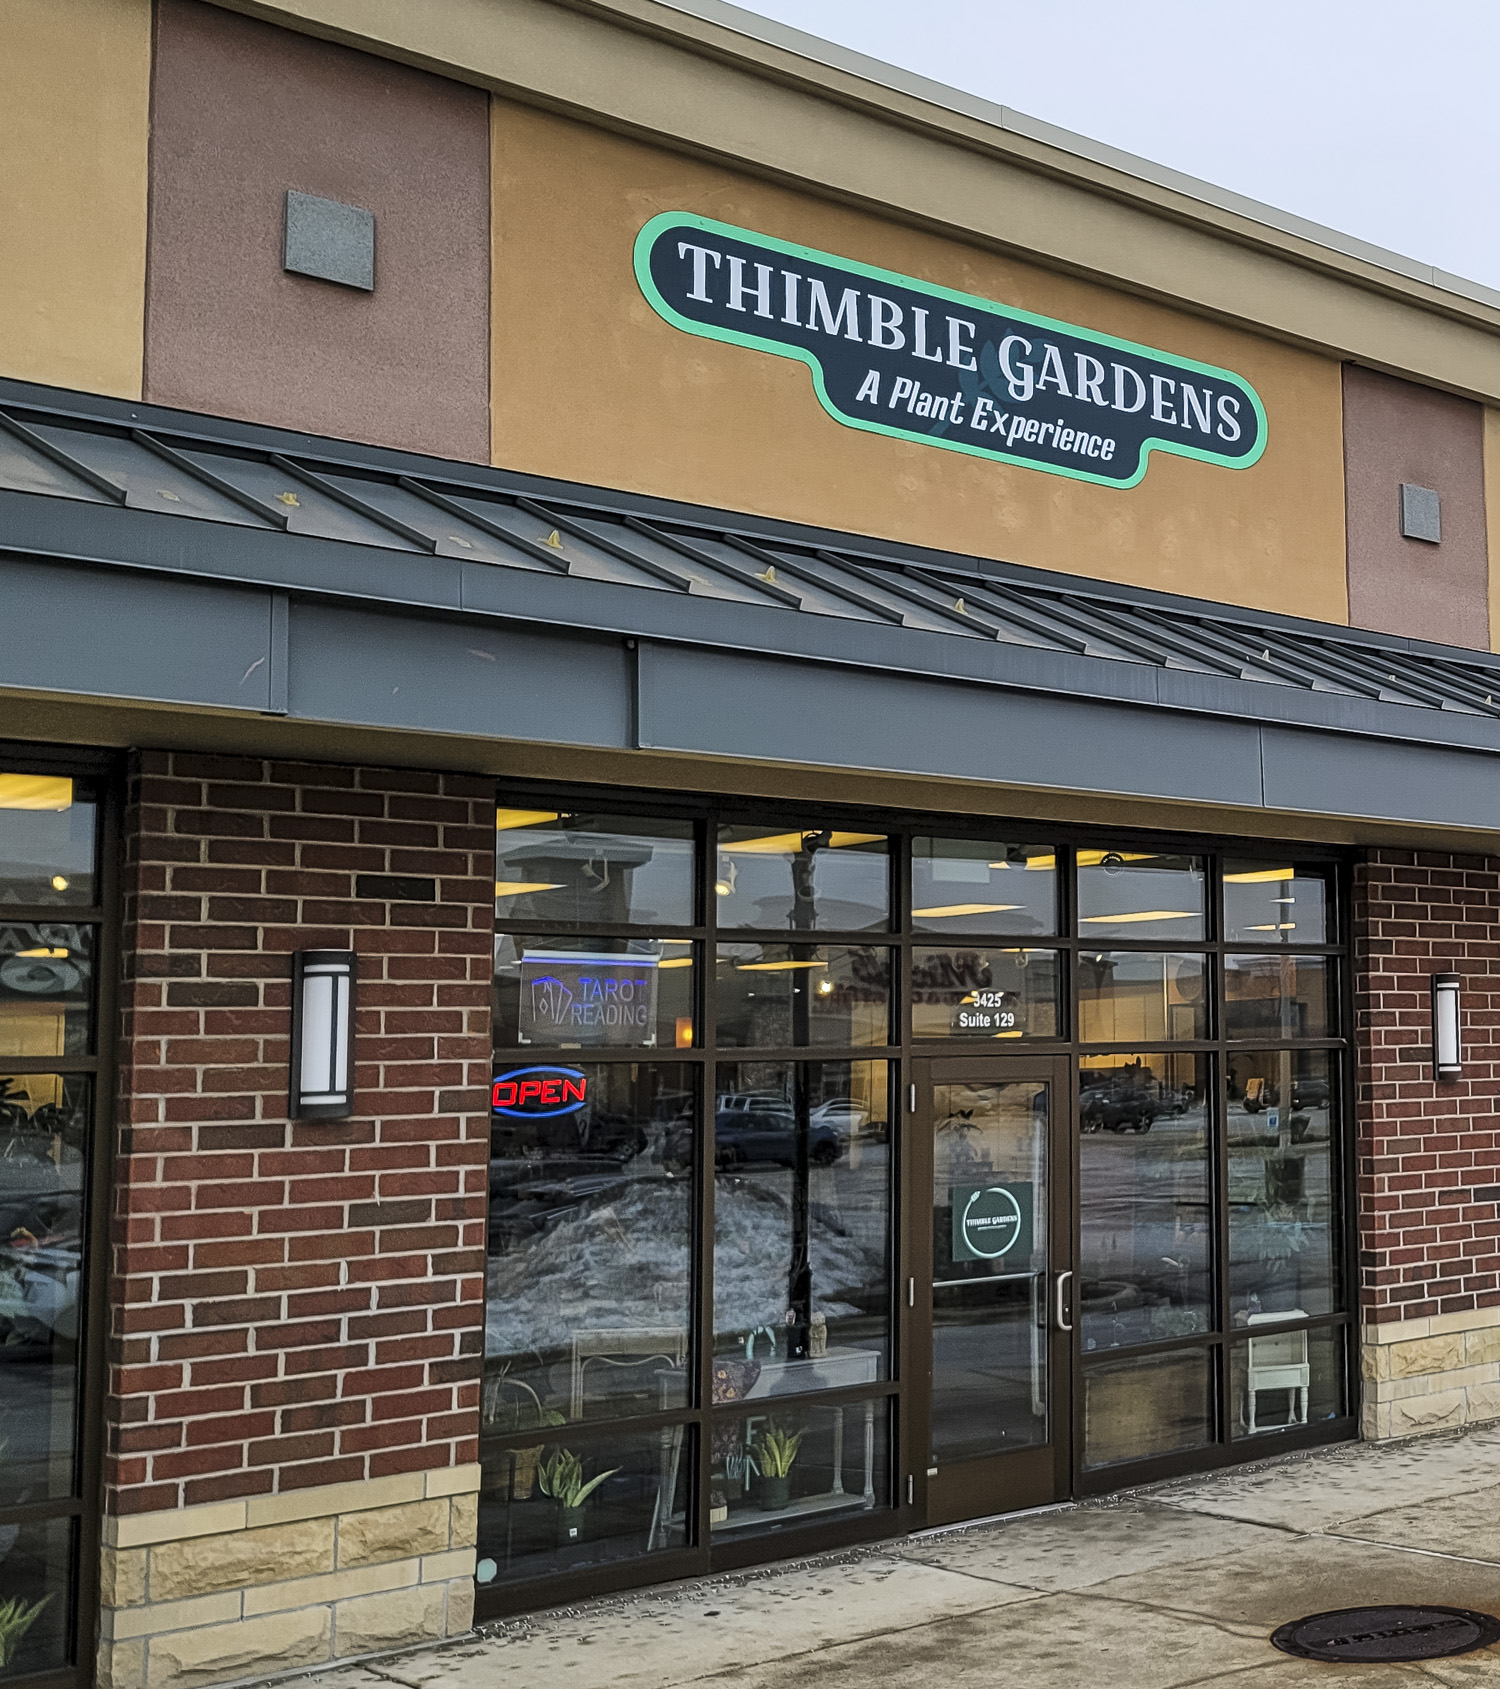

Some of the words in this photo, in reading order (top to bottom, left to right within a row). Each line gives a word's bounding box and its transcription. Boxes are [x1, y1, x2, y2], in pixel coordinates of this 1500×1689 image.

[677, 241, 977, 373] THIMBLE
[998, 334, 1241, 443] GARDENS
[855, 369, 880, 404] A
[888, 375, 965, 426] Plant
[968, 399, 1116, 462] Experience
[578, 977, 648, 1002] TAROT
[571, 1003, 648, 1026] READING
[959, 1012, 991, 1028] Suite
[993, 1012, 1015, 1028] 129
[492, 1078, 587, 1107] OPEN
[966, 1217, 991, 1227] THIMBLE
[991, 1214, 1018, 1225] GARDENS
